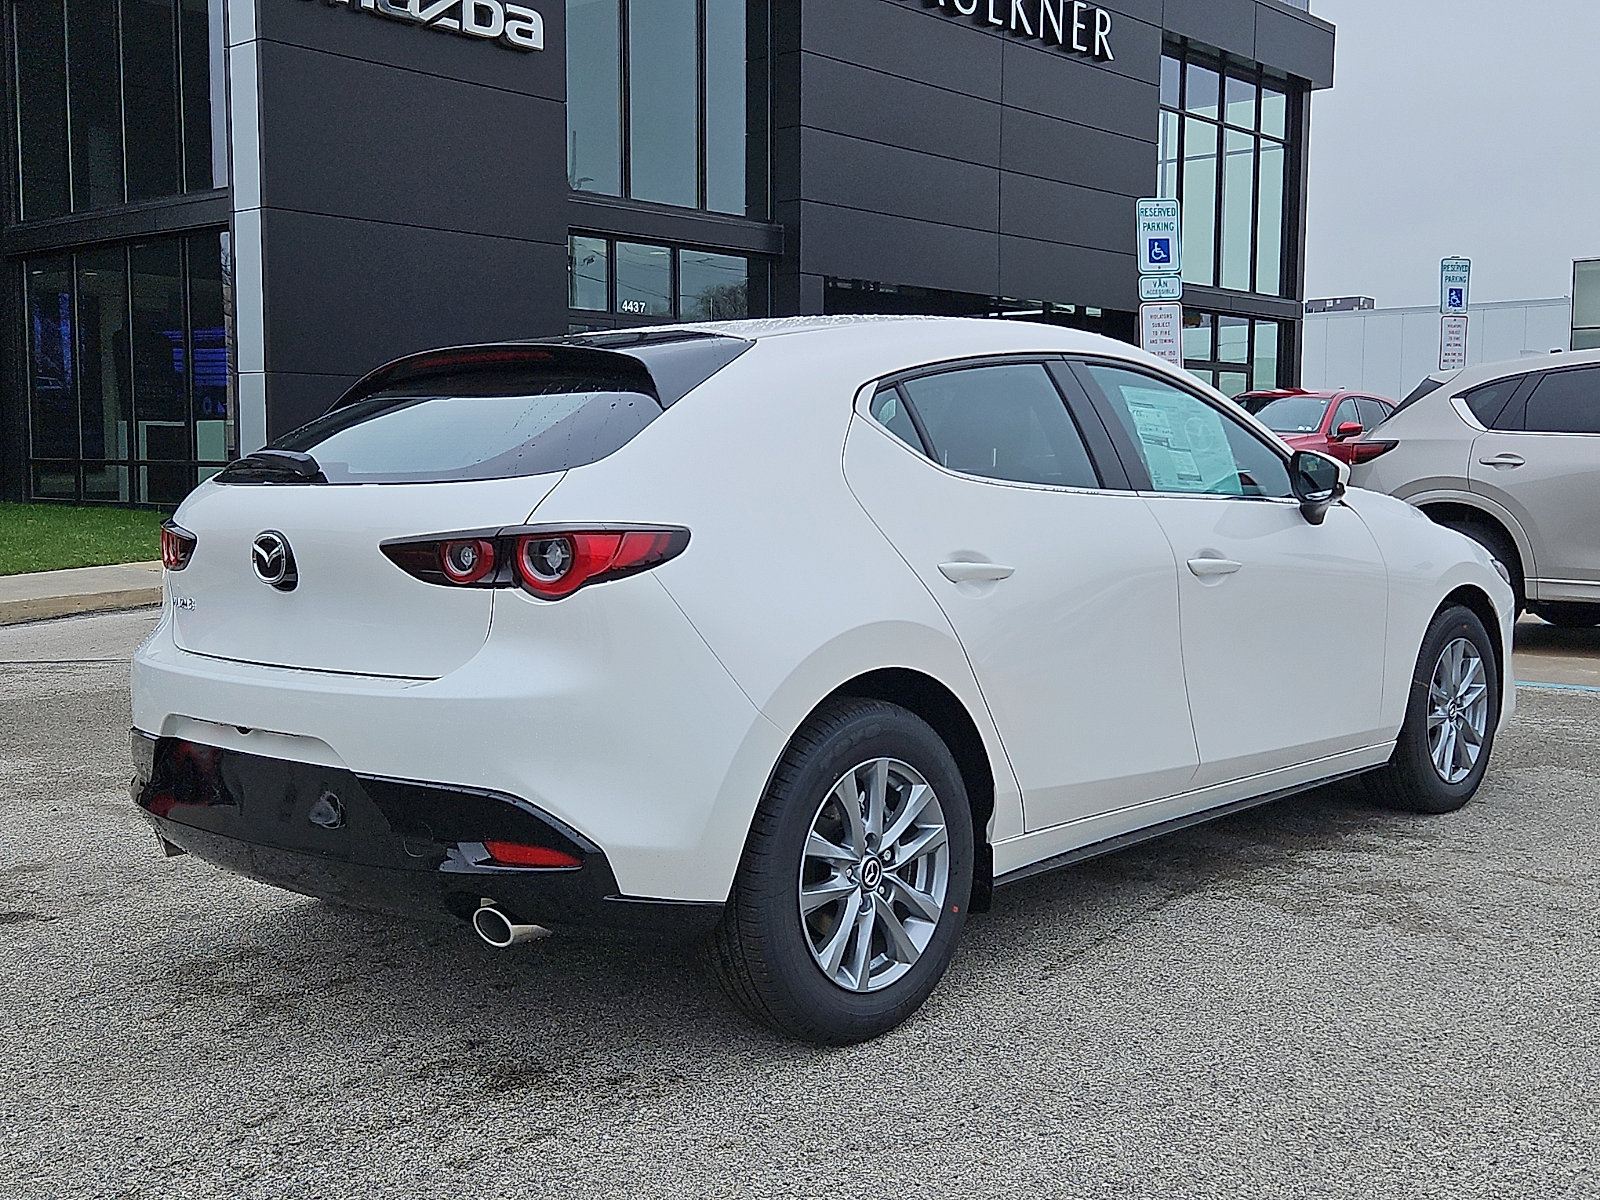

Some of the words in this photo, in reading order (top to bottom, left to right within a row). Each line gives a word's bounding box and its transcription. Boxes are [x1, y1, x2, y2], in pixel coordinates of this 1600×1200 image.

[1140, 207, 1176, 217] RESERVED
[1143, 222, 1175, 232] PARKING
[1152, 280, 1168, 288] VAN
[622, 300, 646, 313] 4437
